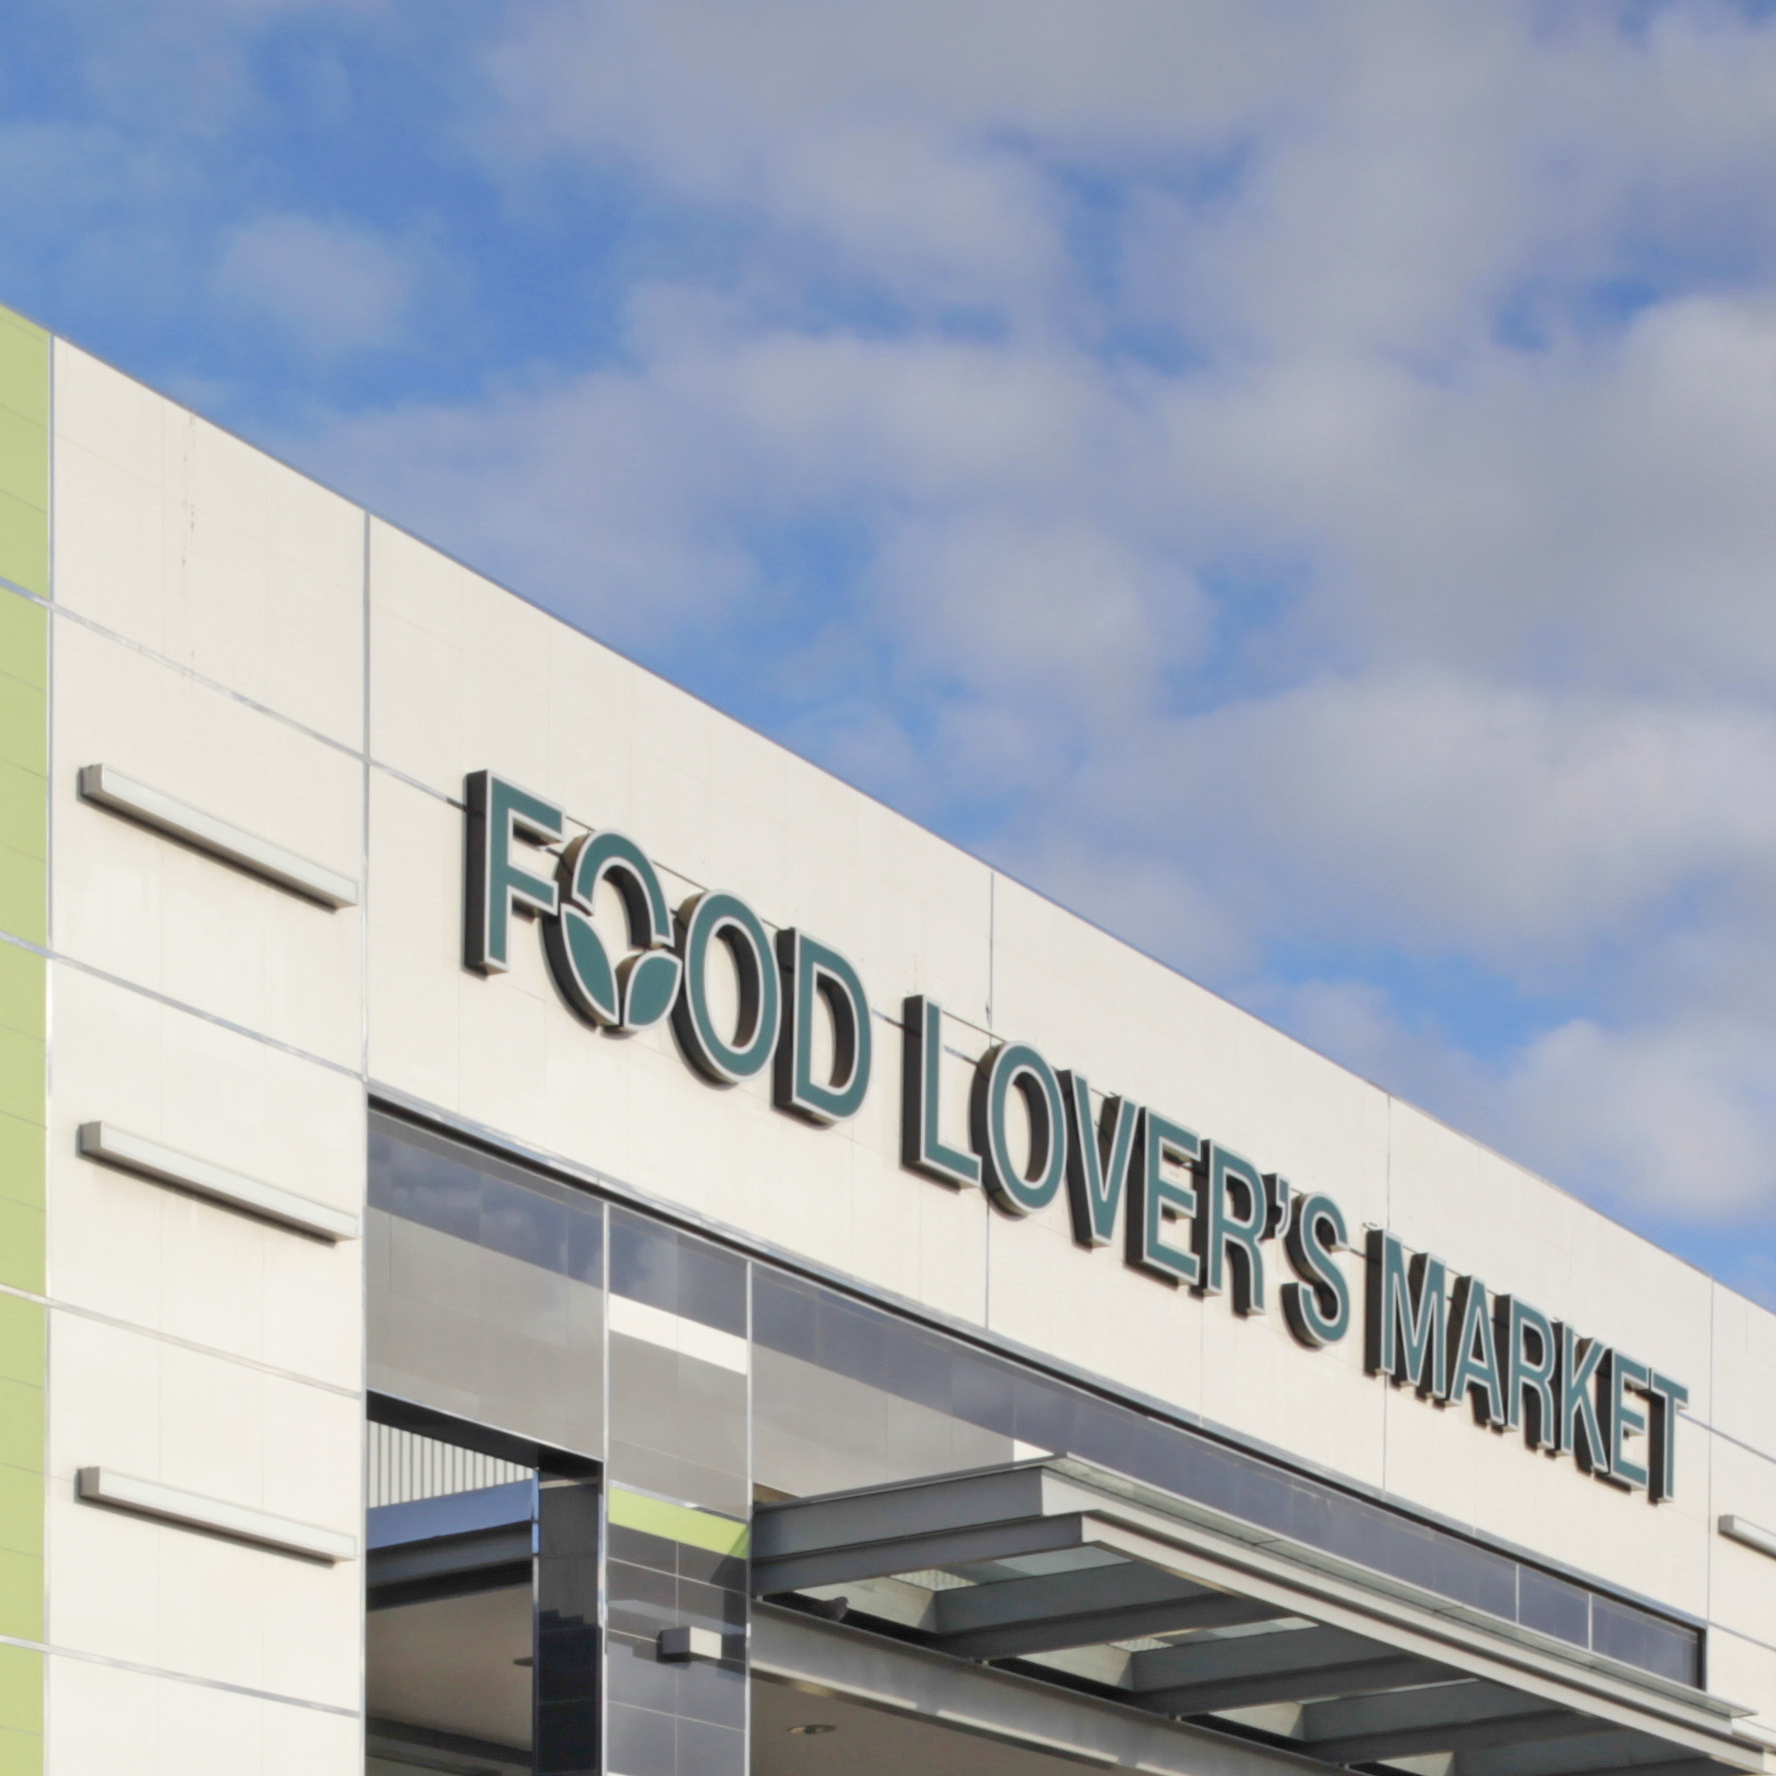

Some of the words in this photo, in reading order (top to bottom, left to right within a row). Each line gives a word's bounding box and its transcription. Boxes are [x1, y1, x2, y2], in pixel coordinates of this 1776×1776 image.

[464, 769, 873, 1128] FOOD
[902, 995, 1351, 1347] LOVER'S
[1366, 1228, 1689, 1505] MARKET
